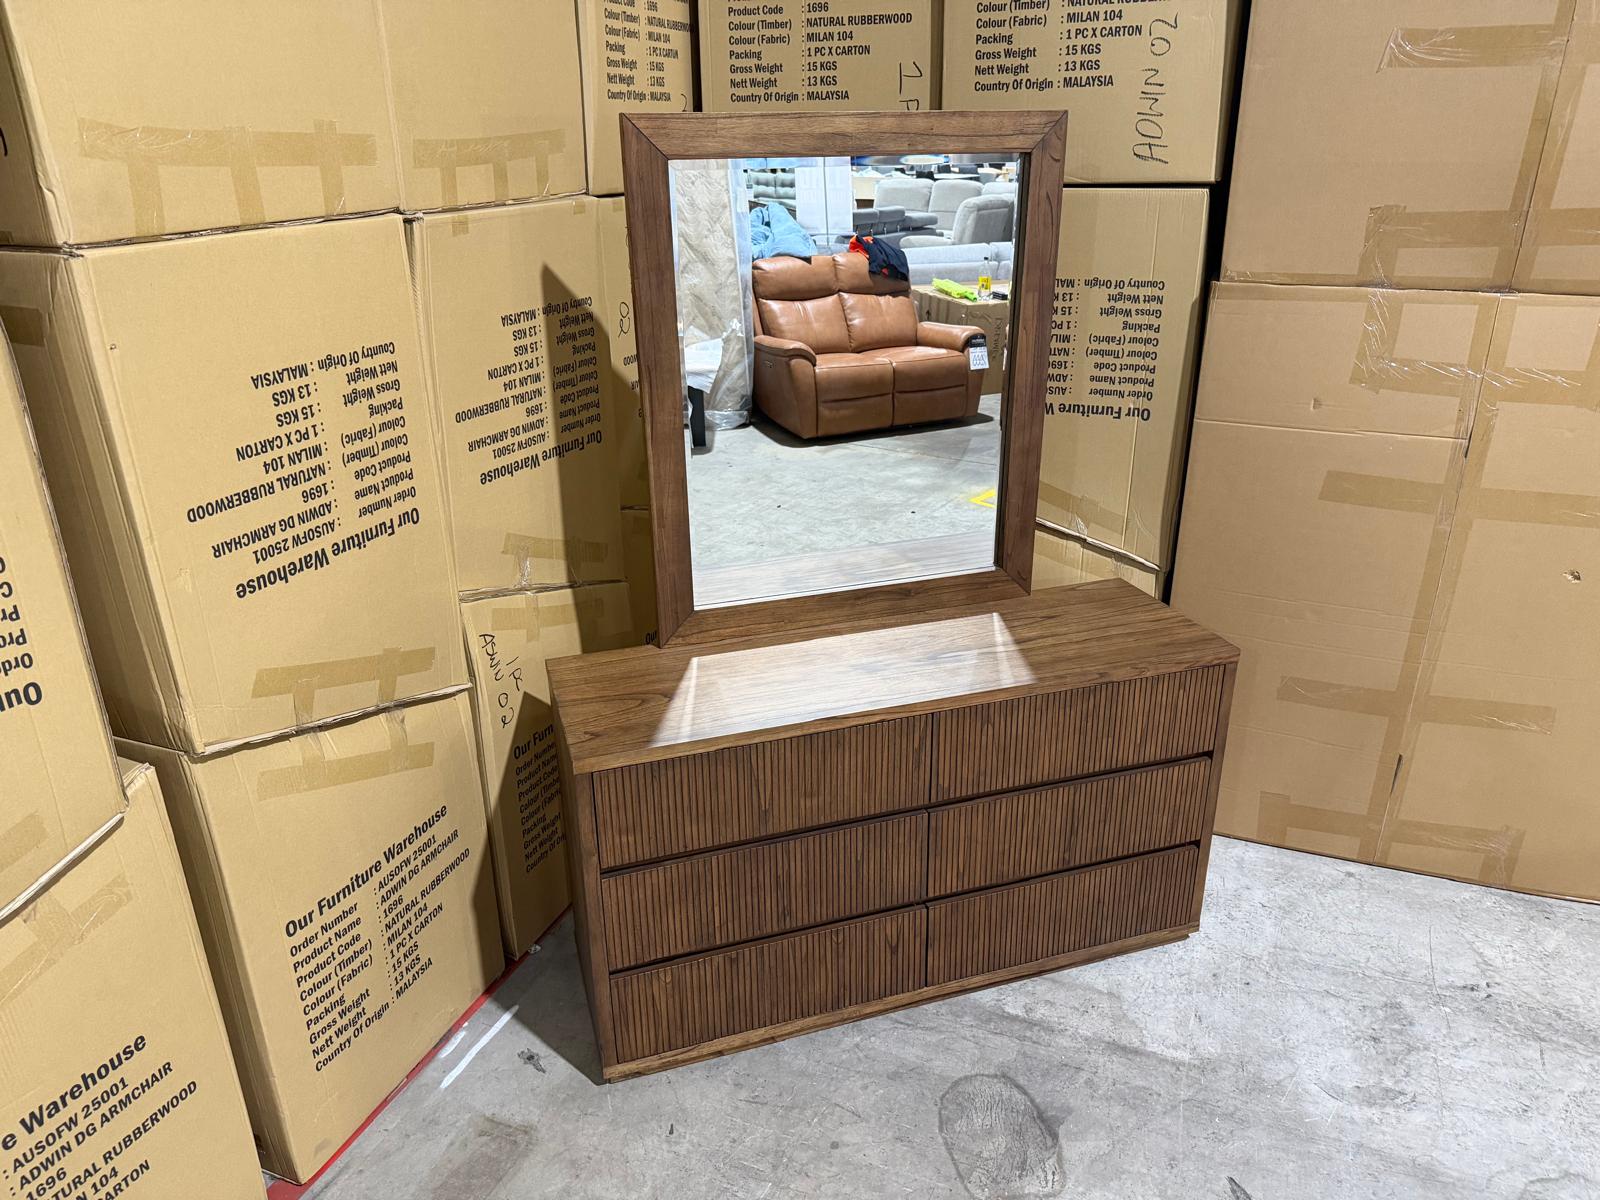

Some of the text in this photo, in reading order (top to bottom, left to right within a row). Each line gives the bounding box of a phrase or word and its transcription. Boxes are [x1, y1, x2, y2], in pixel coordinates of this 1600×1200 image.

[728, 1, 829, 17] Product Code 1696
[728, 13, 912, 33] Colour (Timber) NATURAL RUBBERWOOD
[976, 9, 1123, 30] Colour (Fabric) MILAN 104
[605, 40, 626, 56] Packing
[728, 30, 854, 47] Colour (Fabric) MILAN 104
[975, 24, 1143, 46] Packing 1 PC X CARTON
[729, 44, 871, 62] Packing 1 PC X CARTON
[975, 43, 1102, 61] Gross Weight 15 KGS
[730, 90, 850, 104] Country Of Origin MALAYSIA
[974, 74, 1114, 93] Country Of Origin MALAYSIA
[1084, 276, 1165, 292] Country Of Origin
[500, 308, 537, 327] MALAYSIA
[1099, 305, 1162, 319] Gross Weight
[1121, 320, 1161, 334] Packing
[1085, 346, 1158, 361] Colour (Timber)
[1088, 332, 1159, 347] Colour (Fabric)
[250, 341, 395, 390] Country Of Origin MALAYSIA
[1089, 375, 1155, 388] Product Name
[1093, 361, 1156, 374] Product Code
[271, 359, 398, 407] Nett Weight 13 KGS
[503, 371, 541, 393] MILAN 104
[1088, 388, 1153, 402] Order Number
[275, 378, 401, 428] Gross Weight 15 KGS
[455, 387, 543, 423] NATURAL RUBBERWOOD
[525, 402, 543, 418] 1696
[1058, 402, 1122, 420] Furniture
[1124, 406, 1151, 422] Our
[235, 396, 403, 462] Packing 1 PC X CARTON
[262, 415, 406, 475] Colour (Fabric) MILAN 104
[467, 417, 545, 452] ADWIN DG ARMCHAIR
[480, 429, 602, 485] Our Furniture Warehouse
[492, 431, 546, 460] AUSOFW 25001
[186, 433, 408, 523] Colour (Timber) NATURAL RUBBERWOOD
[301, 450, 411, 503] Product Code 1696
[211, 467, 414, 559] Product Name ADWIN DG ARMCHAIR
[252, 486, 416, 565] Order Number AUSOFW 25001
[235, 507, 420, 599] Our Furniture Warehouse
[285, 805, 447, 938] Our Furniture Warehouse
[290, 834, 437, 958] Order Number AUSOFW 25001
[293, 829, 459, 974] Product Name ADWIN DG ARMCHAIR
[296, 894, 404, 988] Product Code 1696
[300, 848, 470, 1002] Colour (Timber) NATURAL RUBBERWOOD
[303, 902, 428, 1016] Colour (Fabric) MILAN 104
[315, 957, 433, 1072] Country Of Origin MALAYSIA
[19, 1035, 147, 1135] Warehouse
[13, 1077, 129, 1174] AUSOFW 25001
[20, 1061, 173, 1191] ADWIN DG ARMCHAIR
[102, 1081, 197, 1166] RUBBERWOOD
